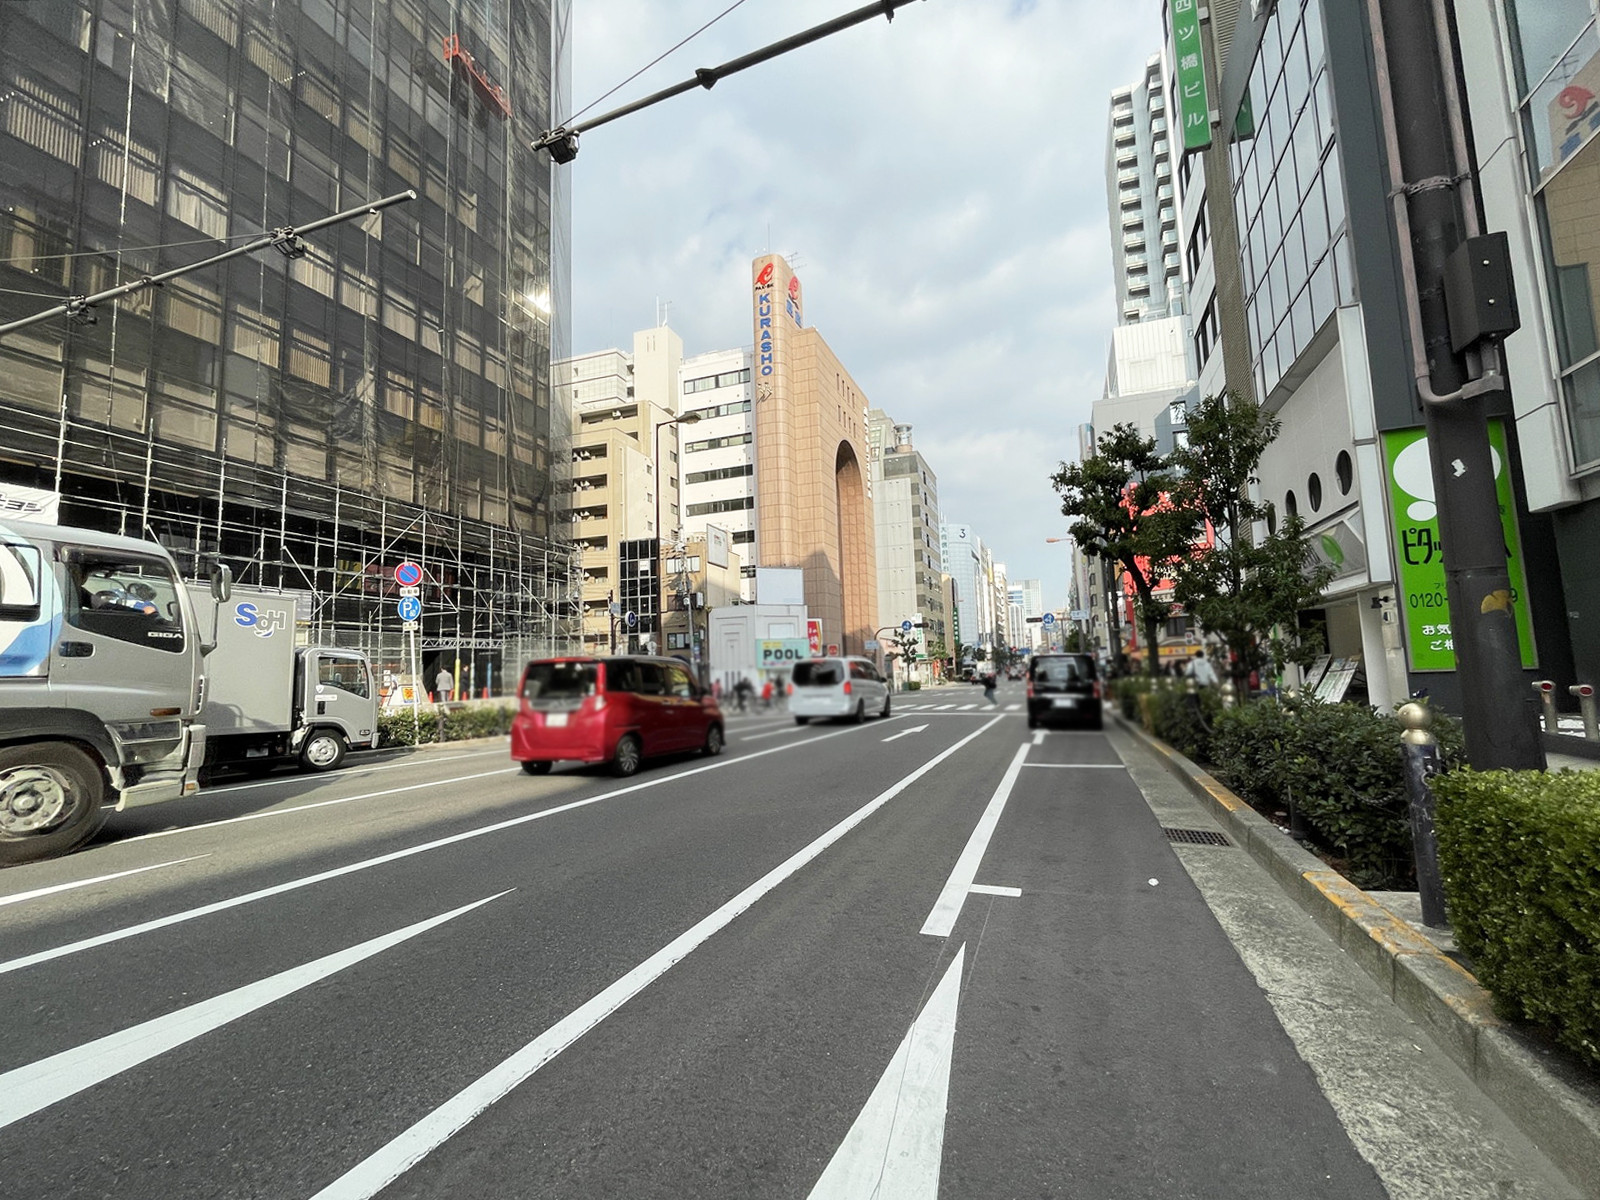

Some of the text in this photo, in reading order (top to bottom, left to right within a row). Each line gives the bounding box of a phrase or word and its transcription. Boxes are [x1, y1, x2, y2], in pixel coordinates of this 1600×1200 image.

[1175, 0, 1204, 127] 四ツ橋ビル
[758, 292, 773, 376] KURASHO
[959, 528, 966, 539] 3
[763, 649, 804, 660] POOL
